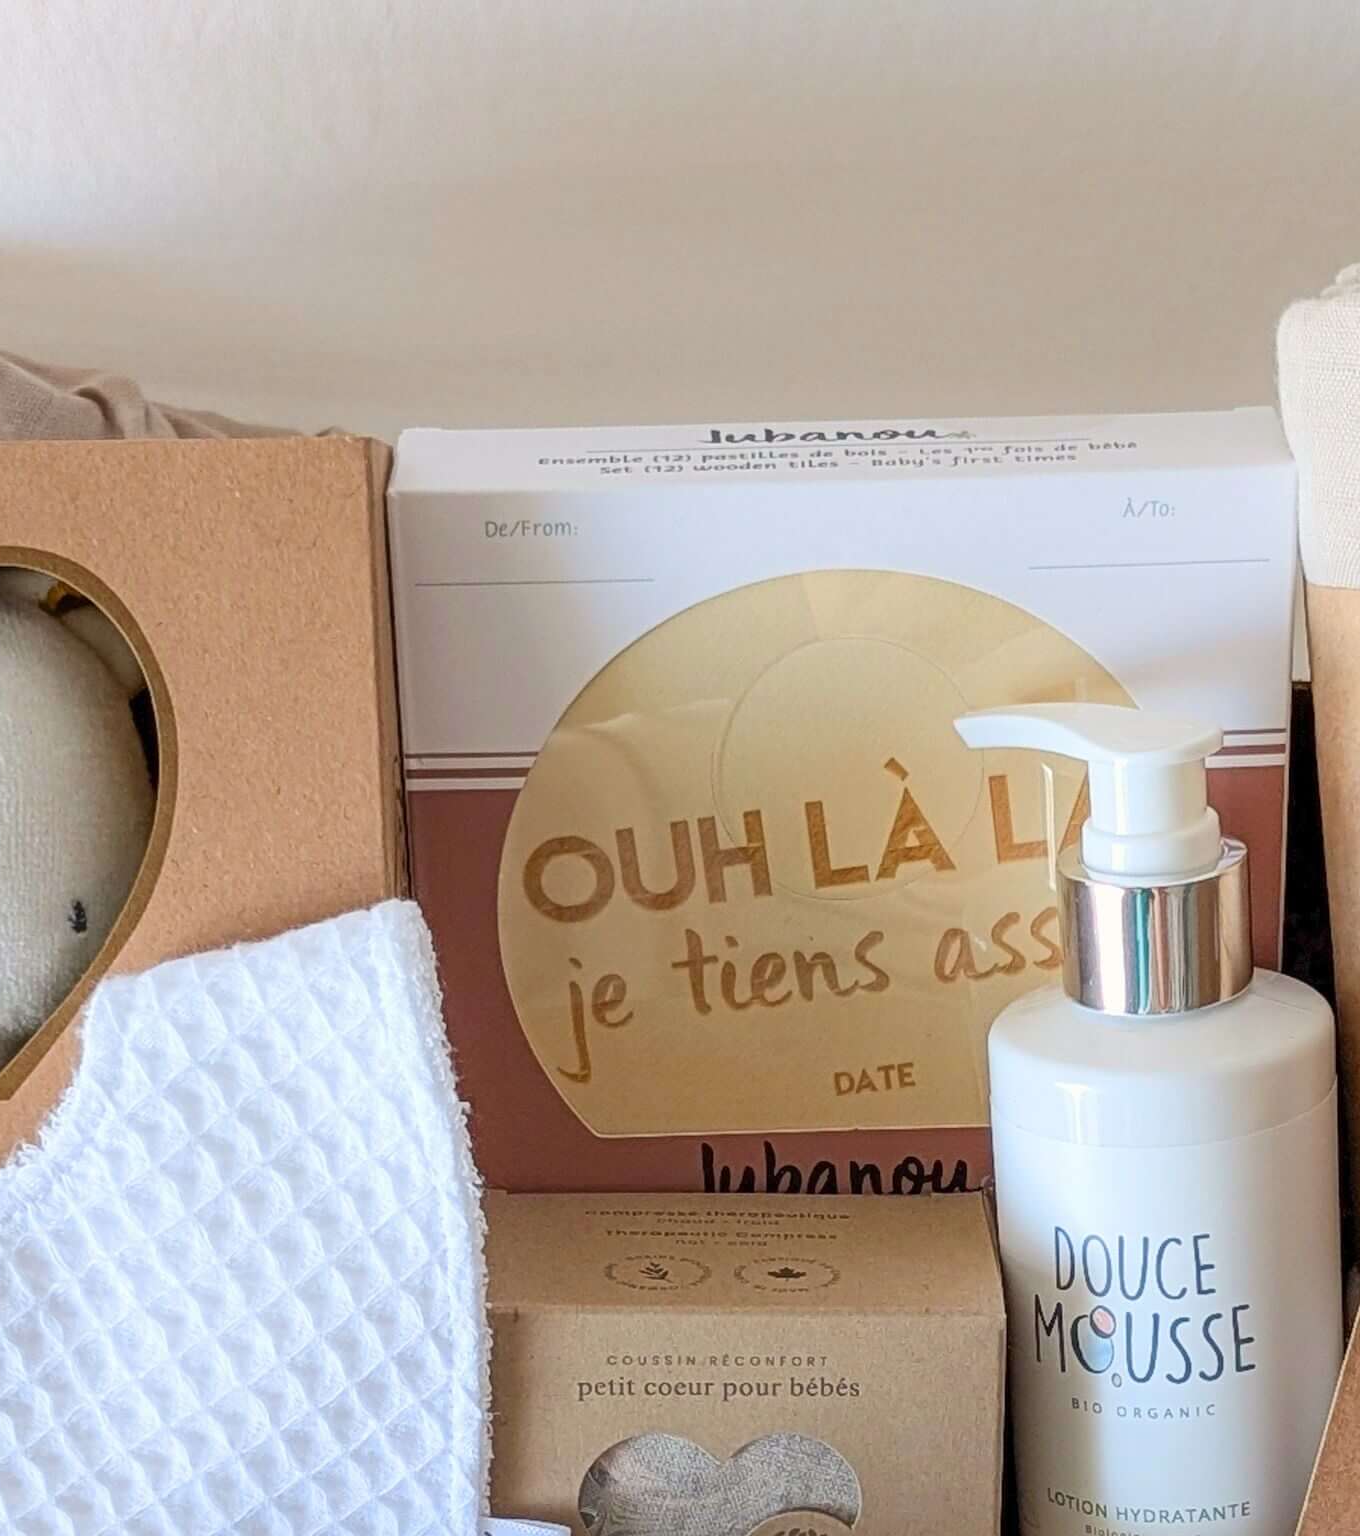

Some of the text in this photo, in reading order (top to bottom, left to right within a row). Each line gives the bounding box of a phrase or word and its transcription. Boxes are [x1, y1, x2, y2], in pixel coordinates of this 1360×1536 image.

[538, 454, 643, 465] Ensemble
[653, 453, 691, 463] (12)
[702, 450, 799, 463] pastilles
[808, 449, 834, 459] de
[844, 447, 888, 457] bois
[919, 446, 953, 455] Les
[1003, 444, 1044, 456] fois
[1053, 442, 1078, 452] de
[598, 465, 633, 475] Set
[644, 464, 684, 474] (12)
[693, 460, 777, 471] wooden
[789, 458, 839, 469] tiles
[871, 456, 941, 468] Baby's
[951, 454, 1004, 467] first
[1014, 453, 1077, 463] times
[1121, 497, 1175, 518] À/To:
[484, 520, 579, 538] De/From:
[522, 809, 773, 923] OUH
[804, 757, 957, 890] LÀ
[558, 957, 635, 1084] je
[671, 926, 892, 1015] tiens
[833, 1062, 917, 1098] DATE
[1053, 1226, 1217, 1301] DOUCE
[1033, 1293, 1257, 1386] MOUSSE
[606, 1353, 829, 1368] COUSSIN RÉCONFORT
[577, 1376, 861, 1402] petit coeur pour bébés
[1071, 1397, 1216, 1420] BIO ORGANIC
[1046, 1487, 1251, 1524] LOTION HYDRATANTE
